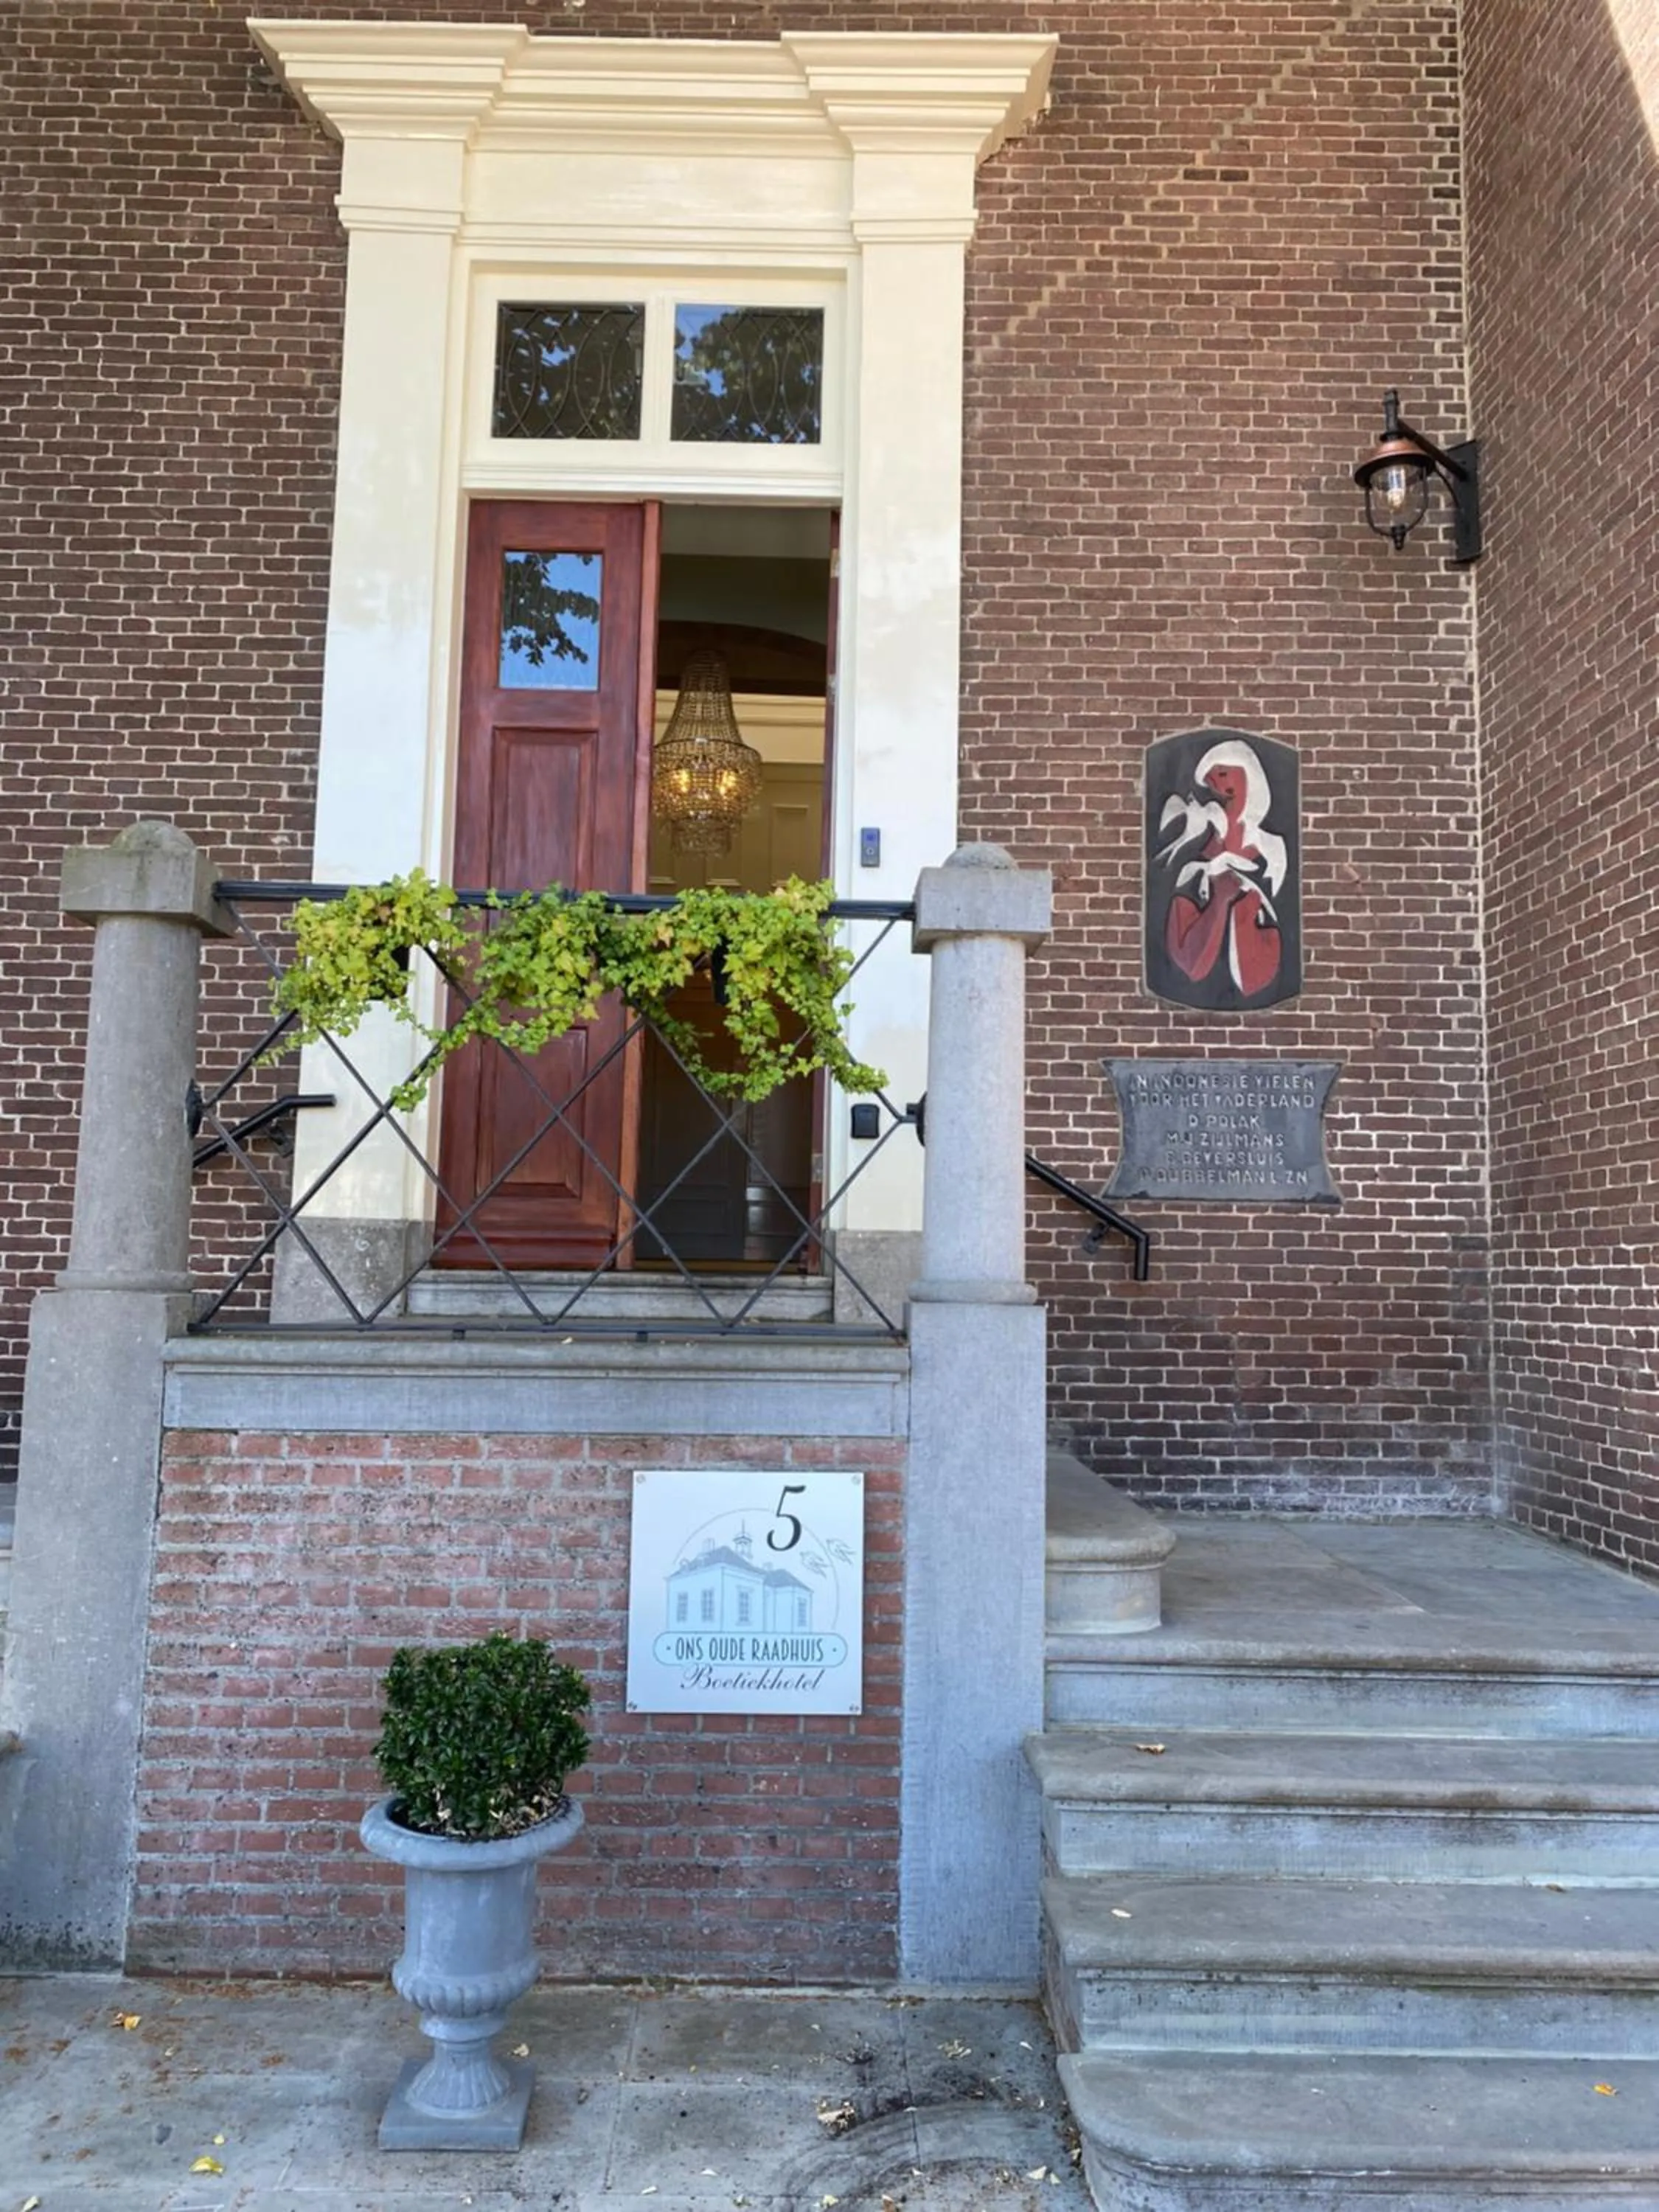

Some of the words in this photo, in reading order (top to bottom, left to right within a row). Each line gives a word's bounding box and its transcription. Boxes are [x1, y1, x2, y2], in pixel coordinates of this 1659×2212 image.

[1180, 1093, 1208, 1107] HET
[1215, 1093, 1315, 1108] VADERLAND
[1206, 1113, 1261, 1130] POLAK
[766, 1485, 806, 1551] 5
[675, 1637, 703, 1661] ONS
[709, 1638, 745, 1661] OUDE
[751, 1638, 824, 1662] RAADHUIS
